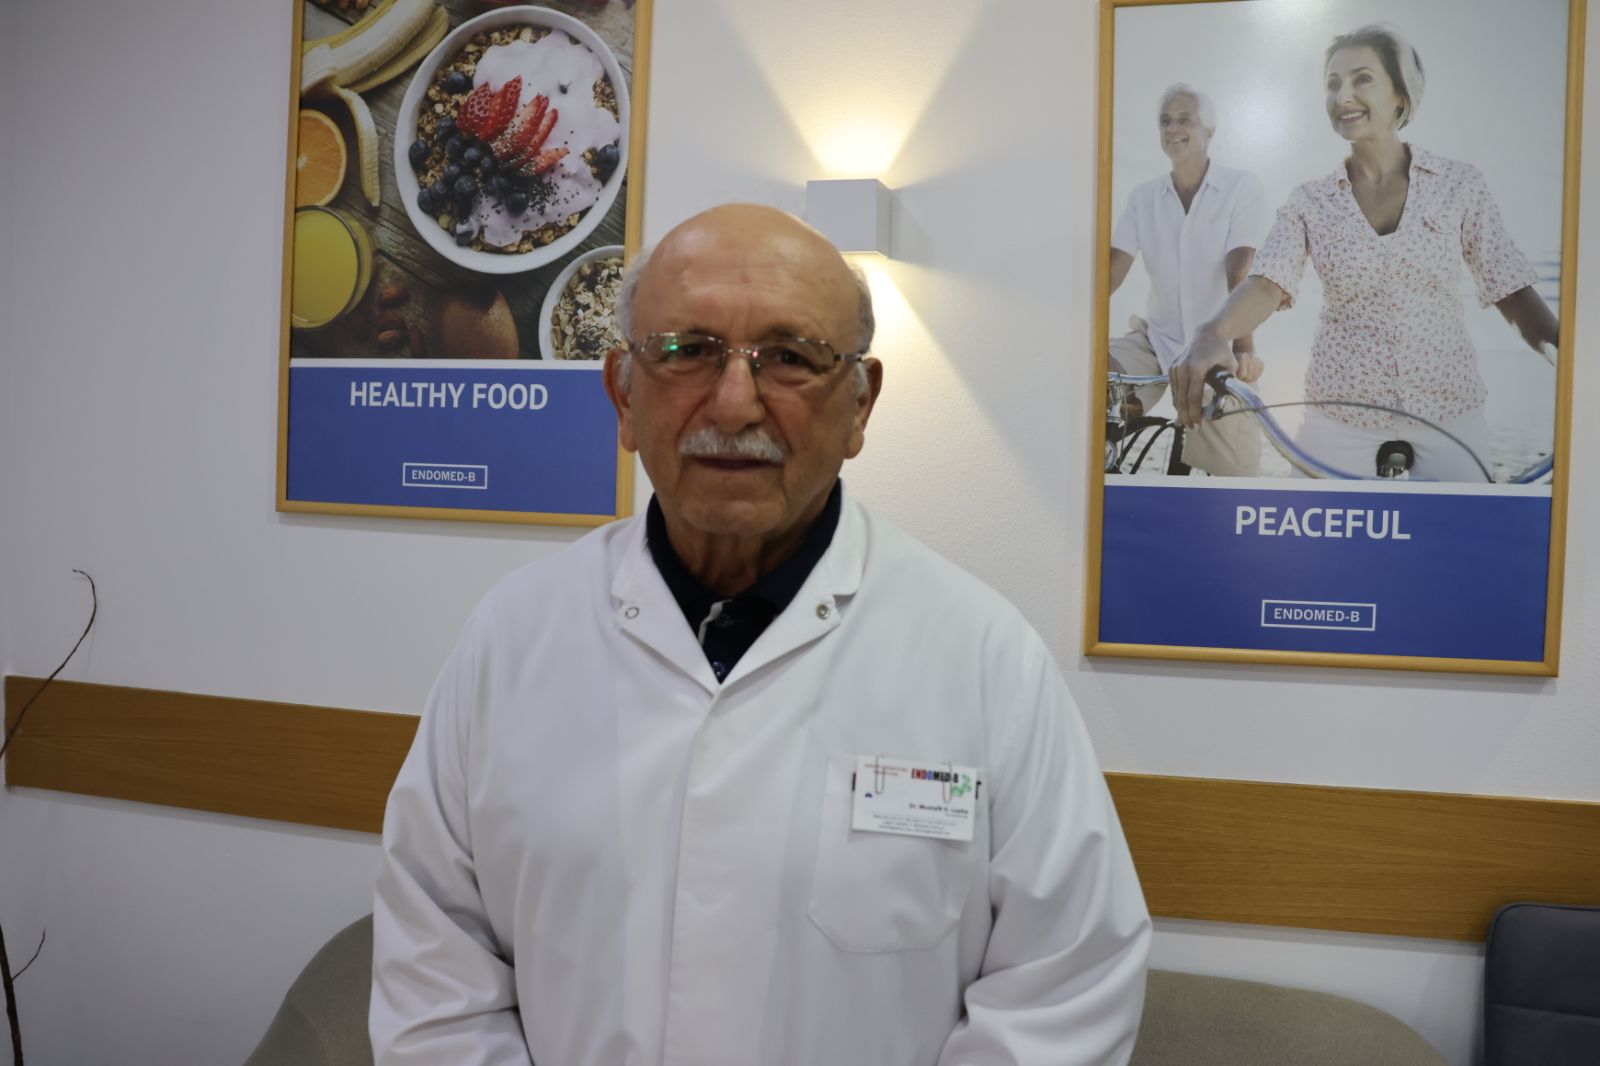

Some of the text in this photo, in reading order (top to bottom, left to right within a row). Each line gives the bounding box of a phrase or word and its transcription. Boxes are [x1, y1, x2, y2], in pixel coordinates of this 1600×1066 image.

[350, 381, 547, 409] HEALTHY FOOD
[411, 469, 476, 482] ENDOMED-B
[1236, 506, 1410, 539] PEACEFUL
[1273, 607, 1360, 623] ENDOMED-B
[911, 768, 958, 783] ENDOMED-B
